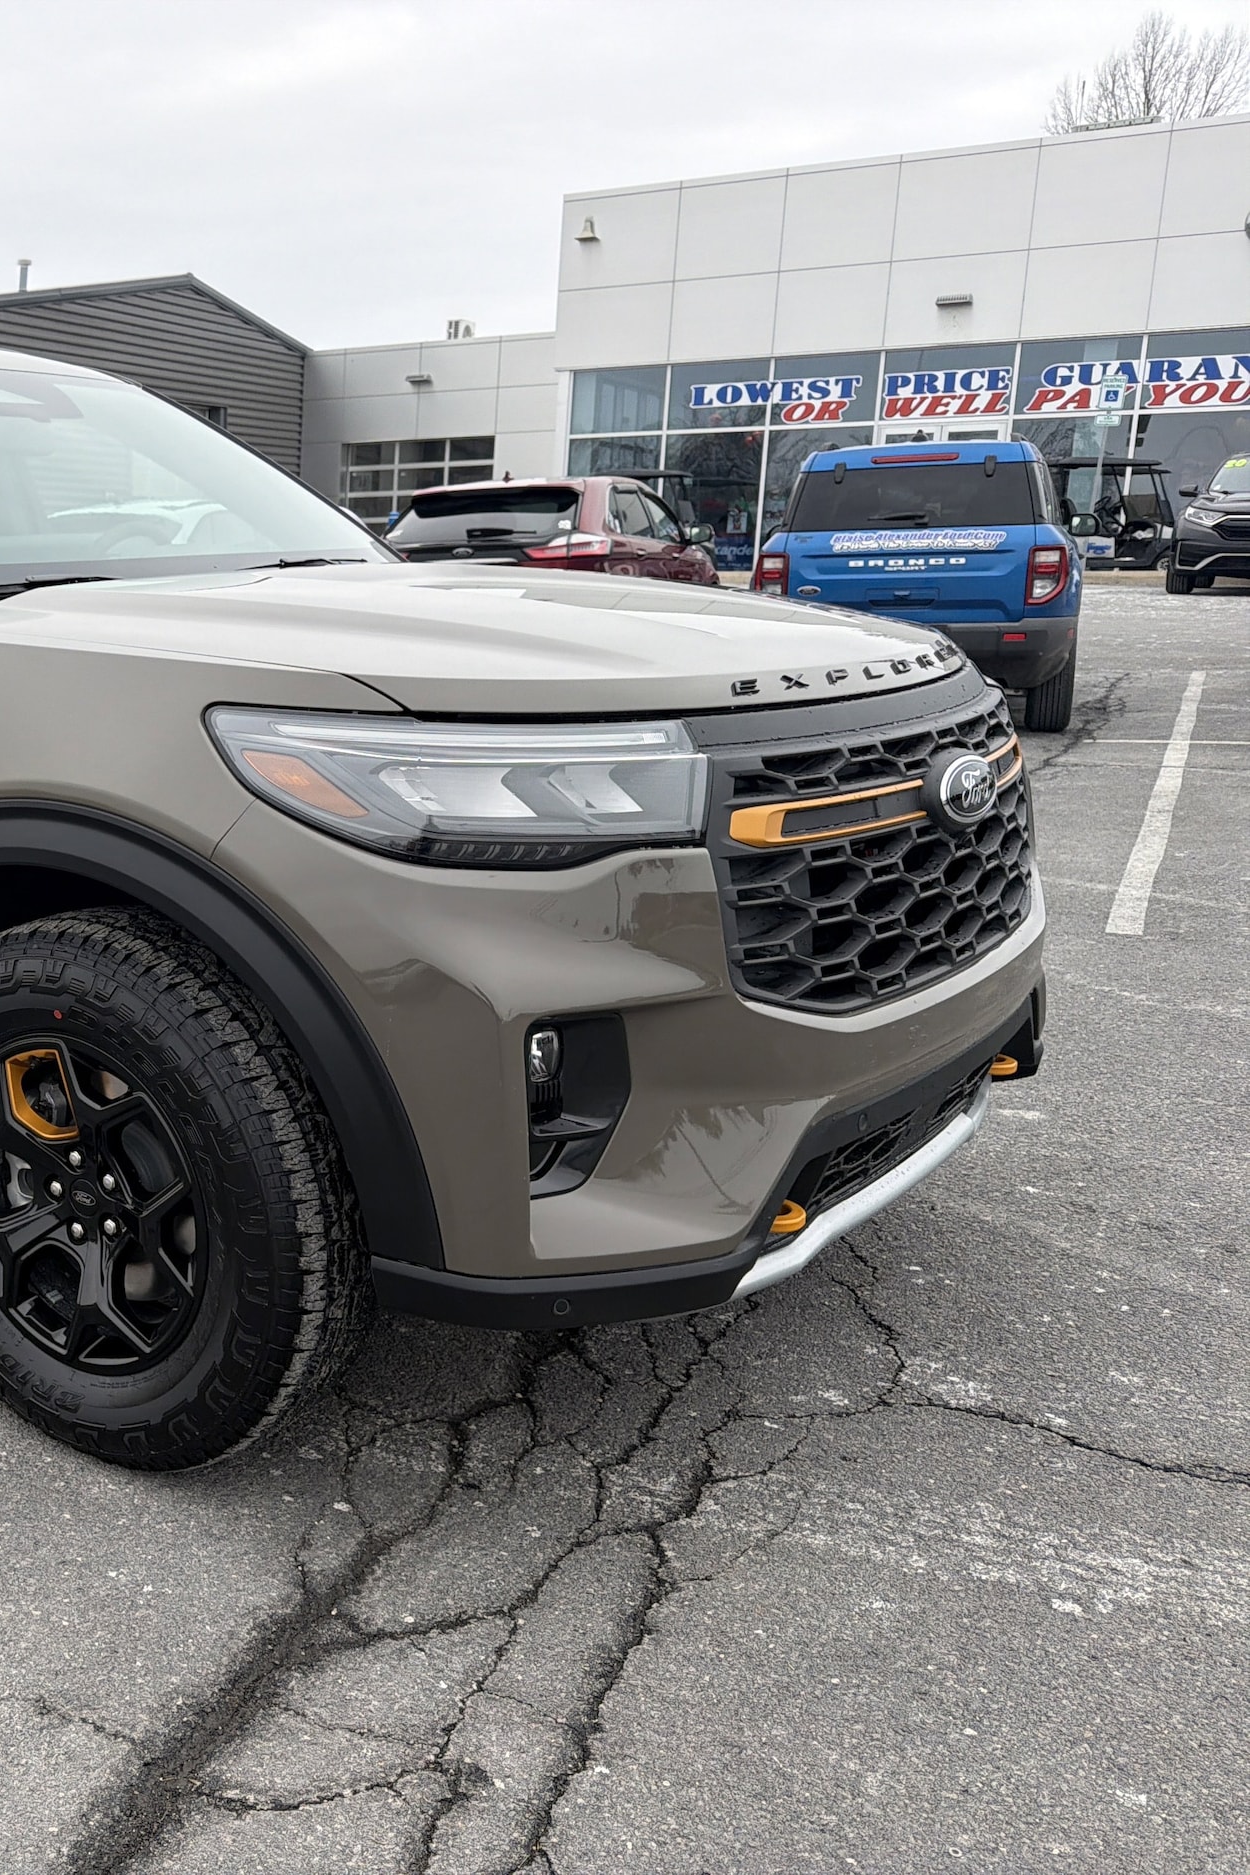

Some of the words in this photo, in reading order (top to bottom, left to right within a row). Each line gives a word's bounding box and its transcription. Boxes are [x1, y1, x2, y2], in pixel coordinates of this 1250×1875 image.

[693, 376, 861, 407] LOWEST
[886, 368, 1011, 397] PRICE
[783, 399, 849, 423] OR
[885, 392, 1008, 418] WE'LL
[1026, 385, 1135, 411] PA
[848, 557, 966, 568] BRONCO
[961, 769, 992, 808] Ford
